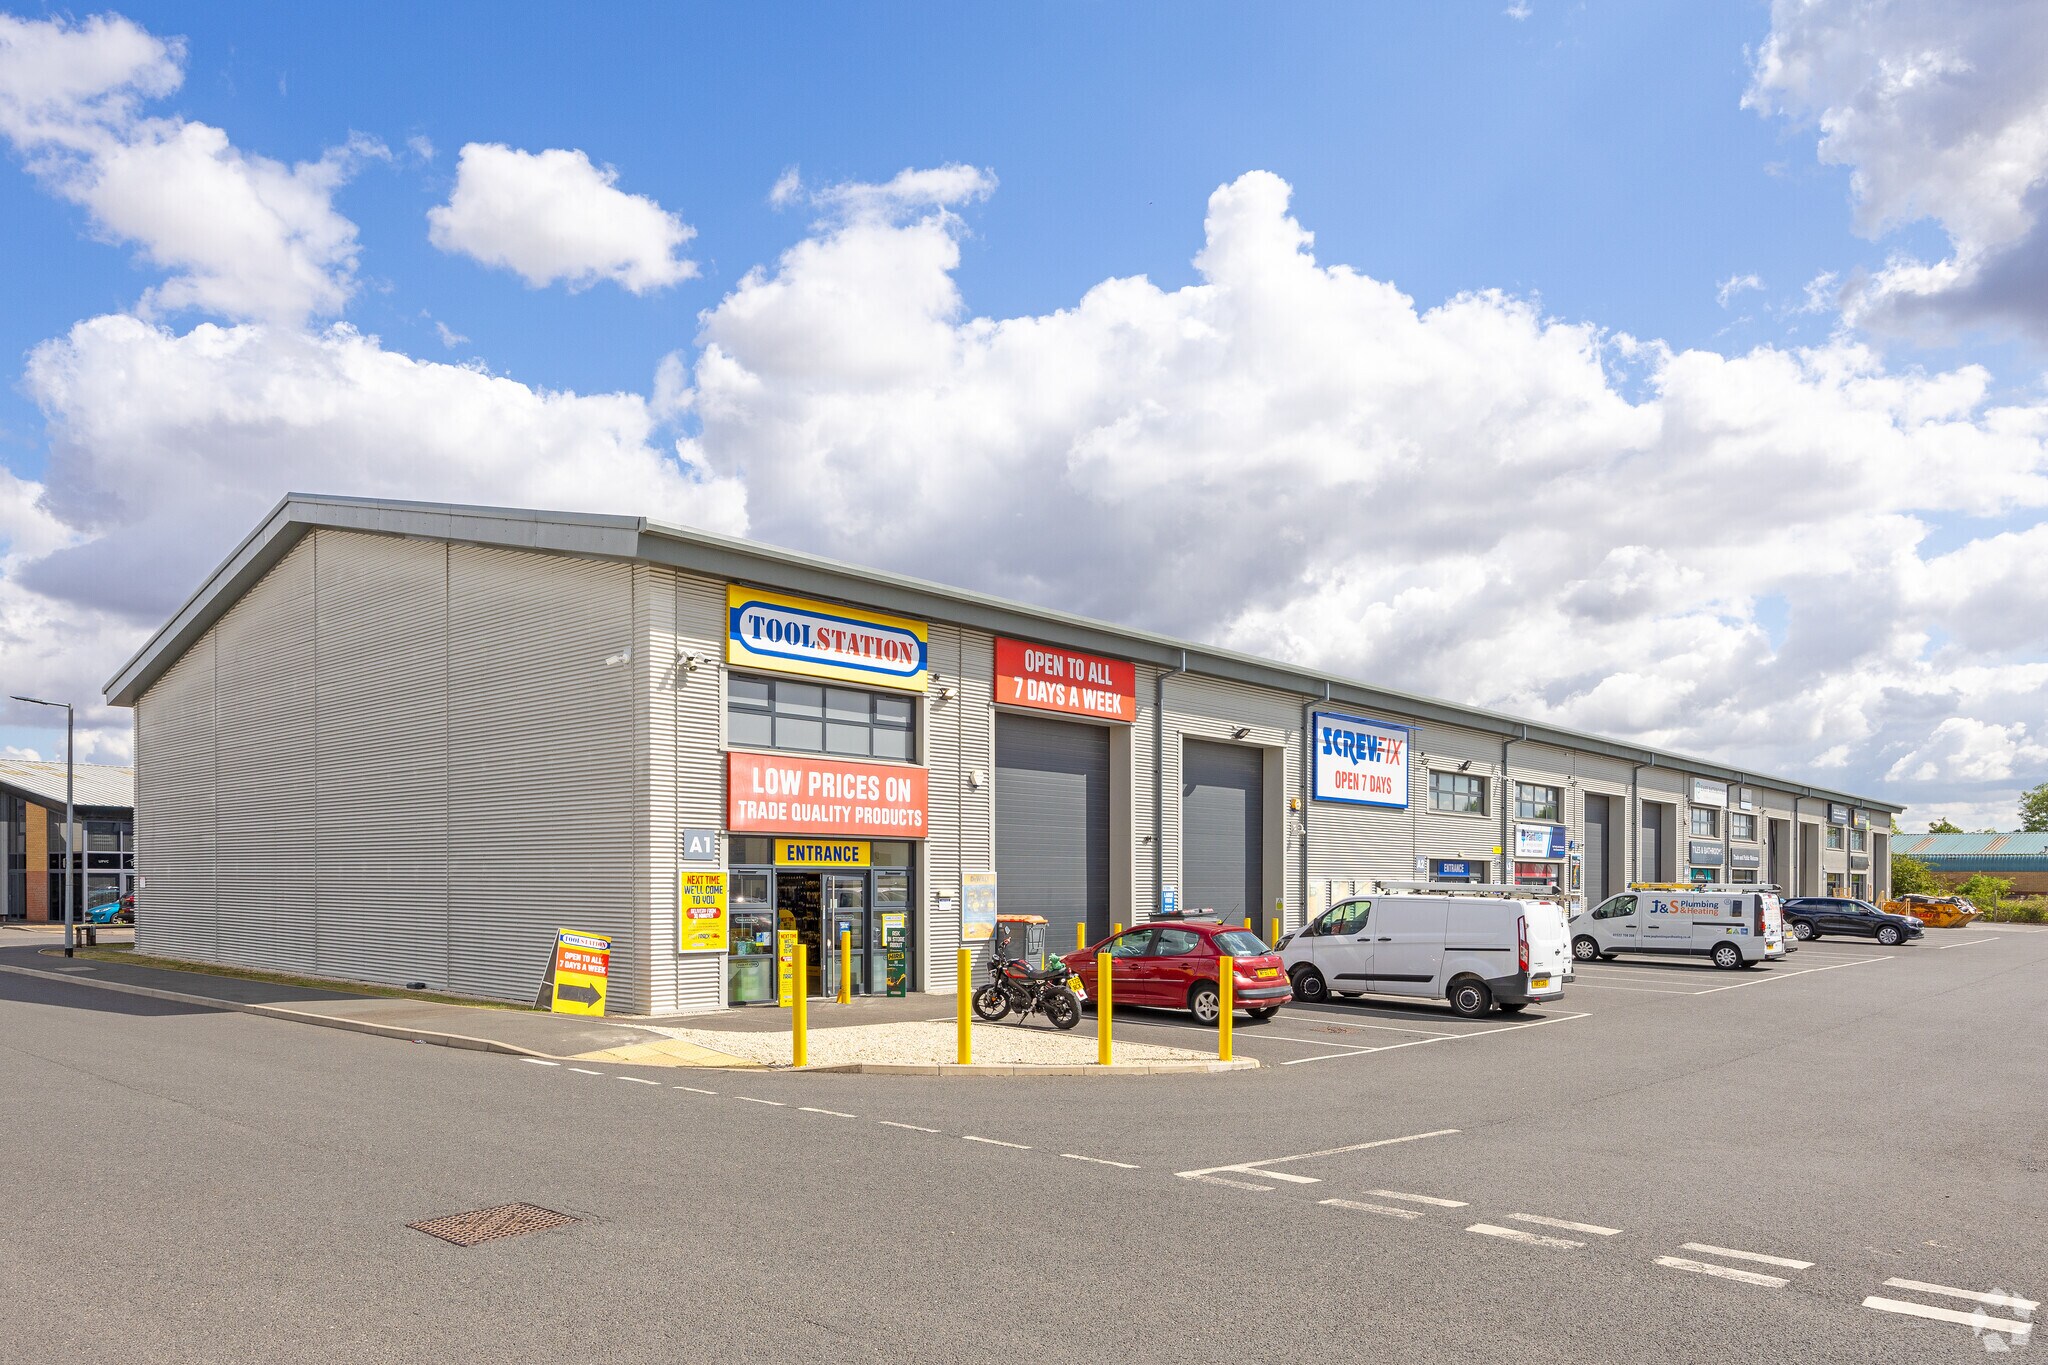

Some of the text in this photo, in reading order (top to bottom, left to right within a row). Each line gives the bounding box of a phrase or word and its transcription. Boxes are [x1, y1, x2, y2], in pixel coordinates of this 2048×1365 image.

[748, 614, 914, 665] TOOLSTATION
[1024, 649, 1113, 686] OPEN TO ALL
[1013, 676, 1122, 714] 7 DAYS A WEEK
[1322, 726, 1403, 766] SCREWFIX
[753, 767, 911, 803] LOW PRICES ON
[1335, 770, 1392, 795] OPEN 7 DAYS
[738, 800, 923, 827] TRADE QUALITY PRODUCTS
[689, 836, 711, 853] A1
[787, 844, 859, 862] ENTRANCE
[1416, 860, 1425, 869] A2
[1443, 863, 1465, 873] ENTRANCE
[687, 875, 720, 884] NEXT TIME
[684, 885, 723, 894] WE'LL COME
[692, 896, 715, 904] TO YOU
[1680, 900, 1719, 910] Plumbing
[565, 936, 606, 947] TOOLSTATION
[564, 952, 581, 961] OPEN
[591, 956, 603, 965] ALL
[564, 961, 581, 970] DAYS
[588, 965, 606, 974] WEEK
